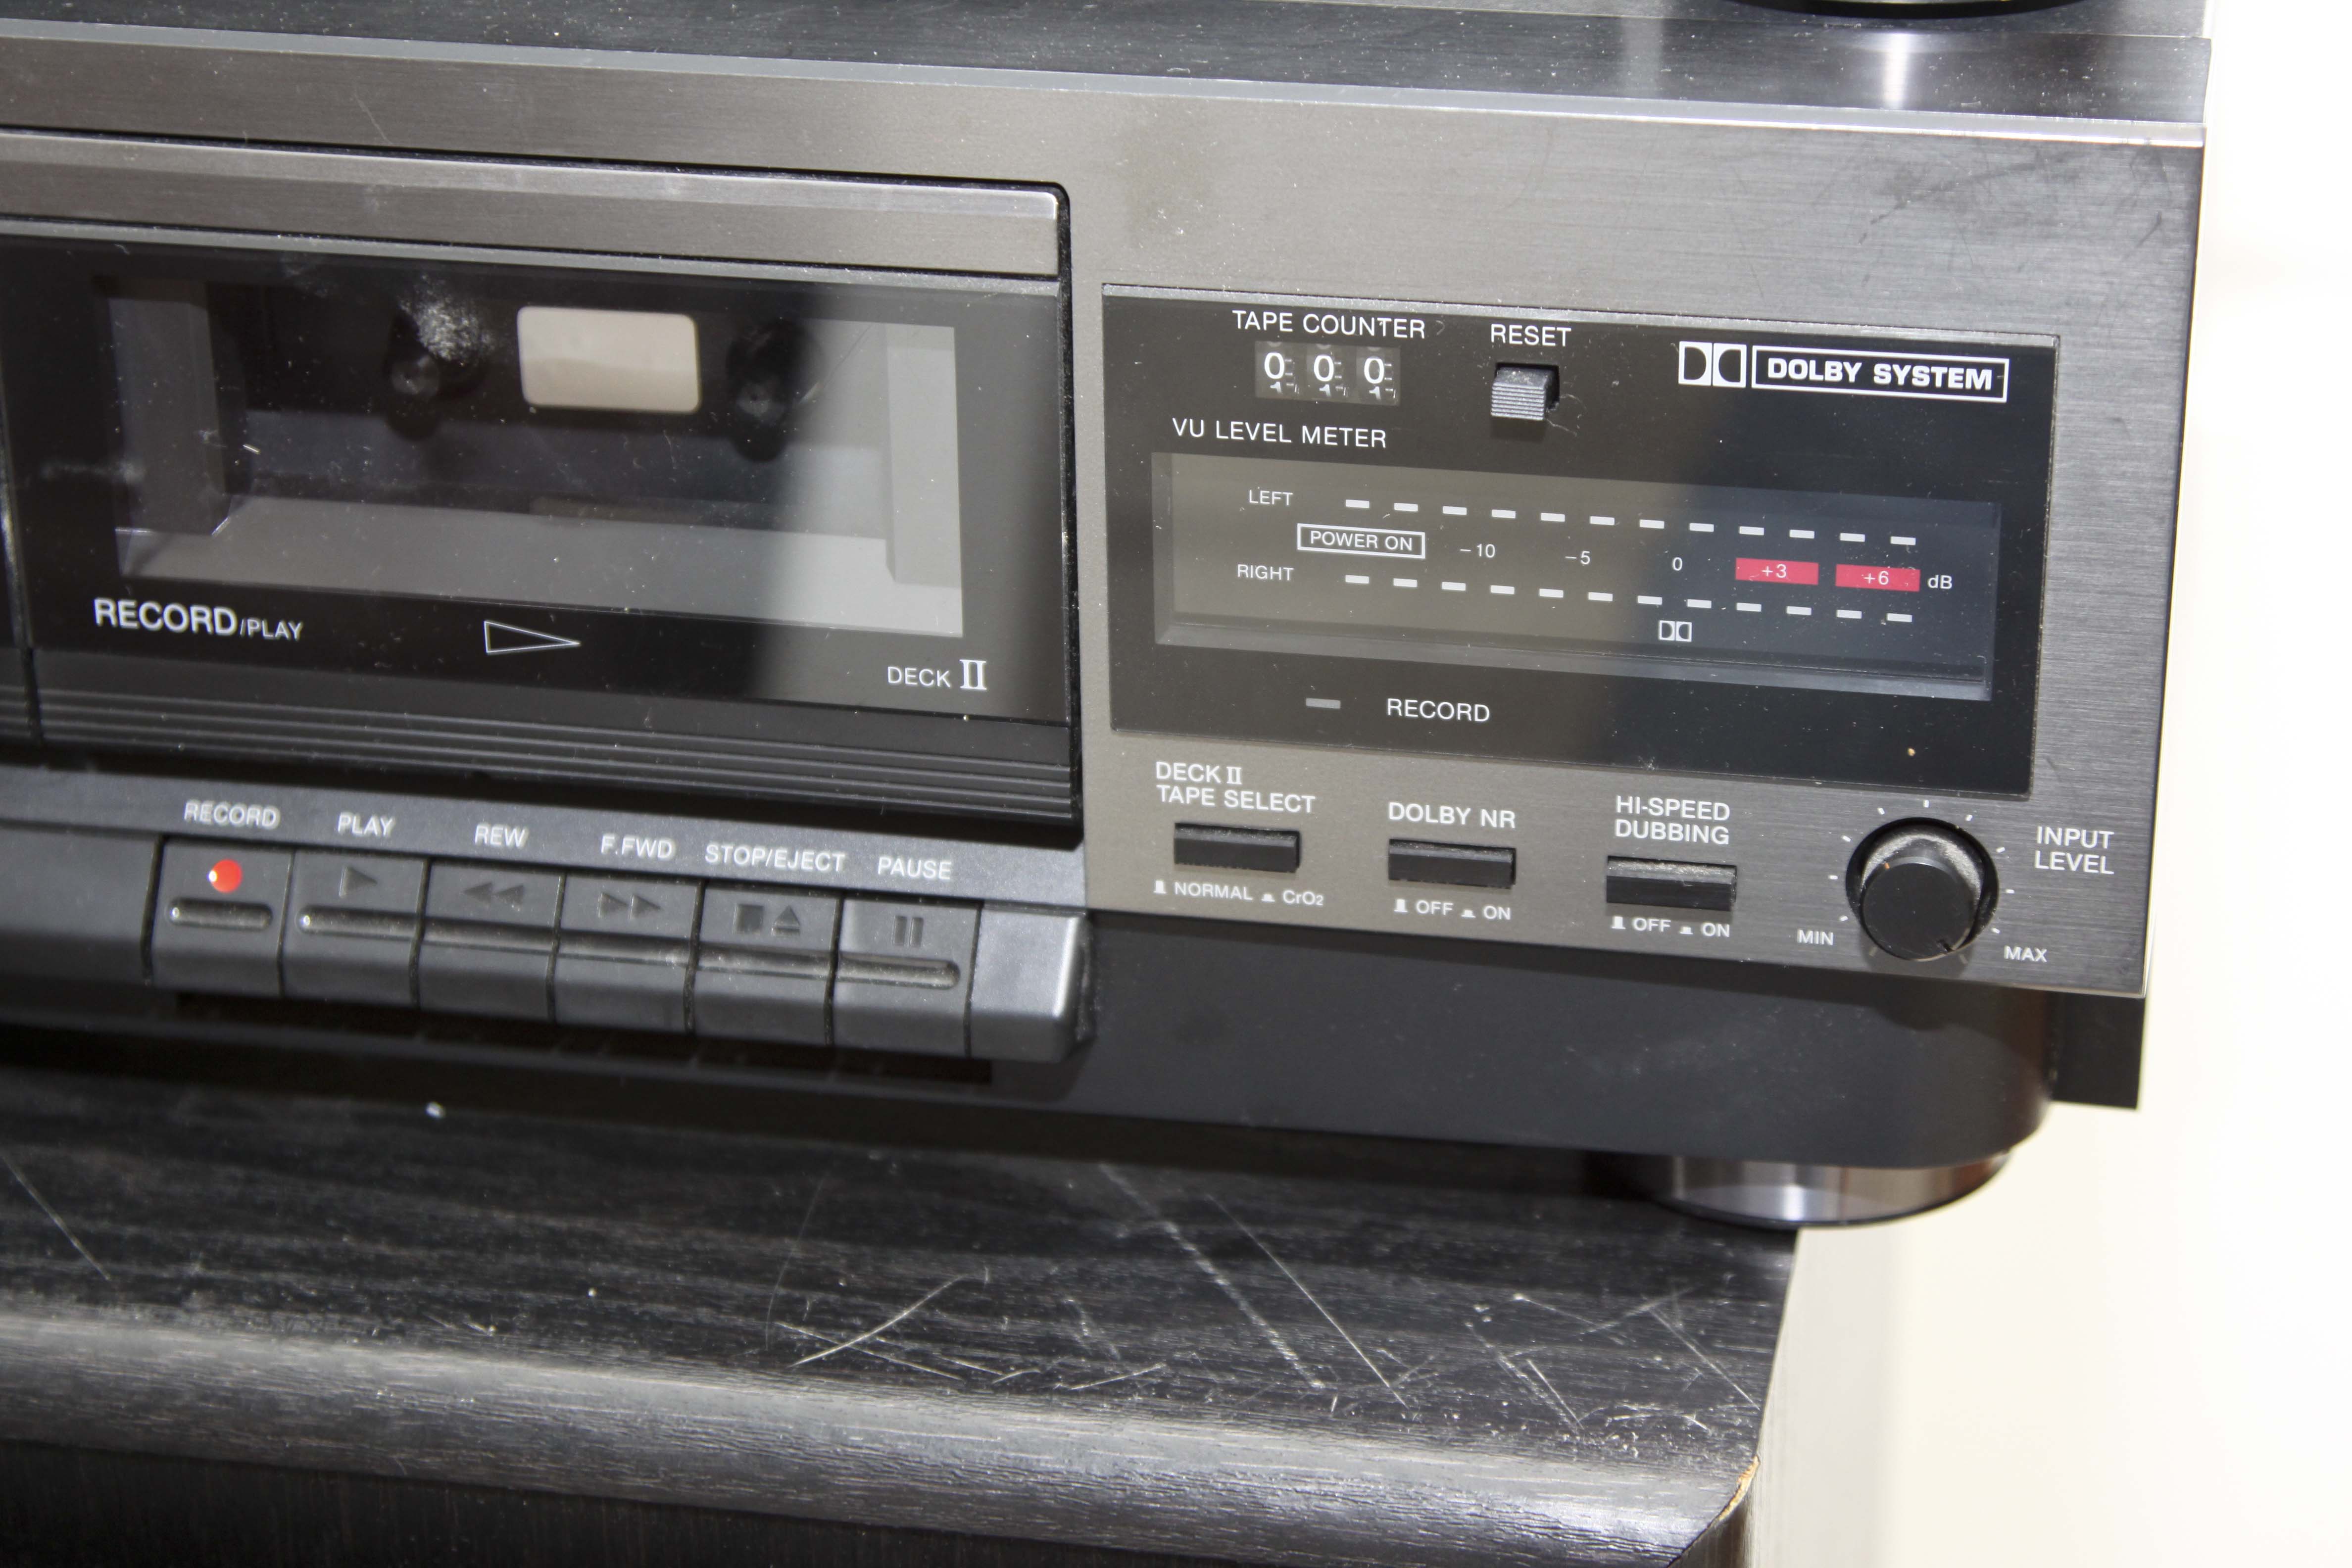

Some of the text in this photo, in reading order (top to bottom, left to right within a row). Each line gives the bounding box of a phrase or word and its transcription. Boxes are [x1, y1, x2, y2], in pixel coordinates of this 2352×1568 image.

[1232, 310, 1425, 339] TAPE COUNTER
[1491, 323, 1572, 347] RESET
[1767, 358, 1992, 390] DOLBY SYSTEM
[1172, 417, 1386, 448] VU LEVEL METER
[1249, 490, 1293, 506] LEFT
[1311, 530, 1412, 551] POWER ON
[1237, 564, 1294, 581] RIGHT
[1762, 563, 1787, 579] +3
[1863, 570, 1889, 586] +6
[1927, 574, 1953, 589] dB
[94, 597, 302, 639] RECORD/PLAY
[887, 659, 987, 690] DECK II
[1387, 698, 1490, 722] RECORD
[1156, 761, 1242, 785] DECK II
[1156, 784, 1316, 813] TAPE SELECT
[1616, 795, 1730, 821] HI-SPEED
[184, 800, 281, 830] RECORD
[337, 812, 394, 836] PLAY
[1388, 801, 1516, 829] DOLBY NR
[474, 823, 528, 848] REW
[1615, 819, 1729, 845] DUBBING
[2036, 826, 2115, 849] INPUT
[600, 833, 676, 860] F.FWD
[704, 842, 846, 873] STOP/EJECT
[878, 855, 952, 881] PAUSE
[2034, 850, 2114, 875] LEVEL
[1174, 881, 1253, 901] NORMAL
[1416, 899, 1511, 920] OFF ON
[1632, 917, 1730, 937] OFF ON
[1797, 929, 1834, 946] MIN
[2004, 946, 2048, 963] MAX
